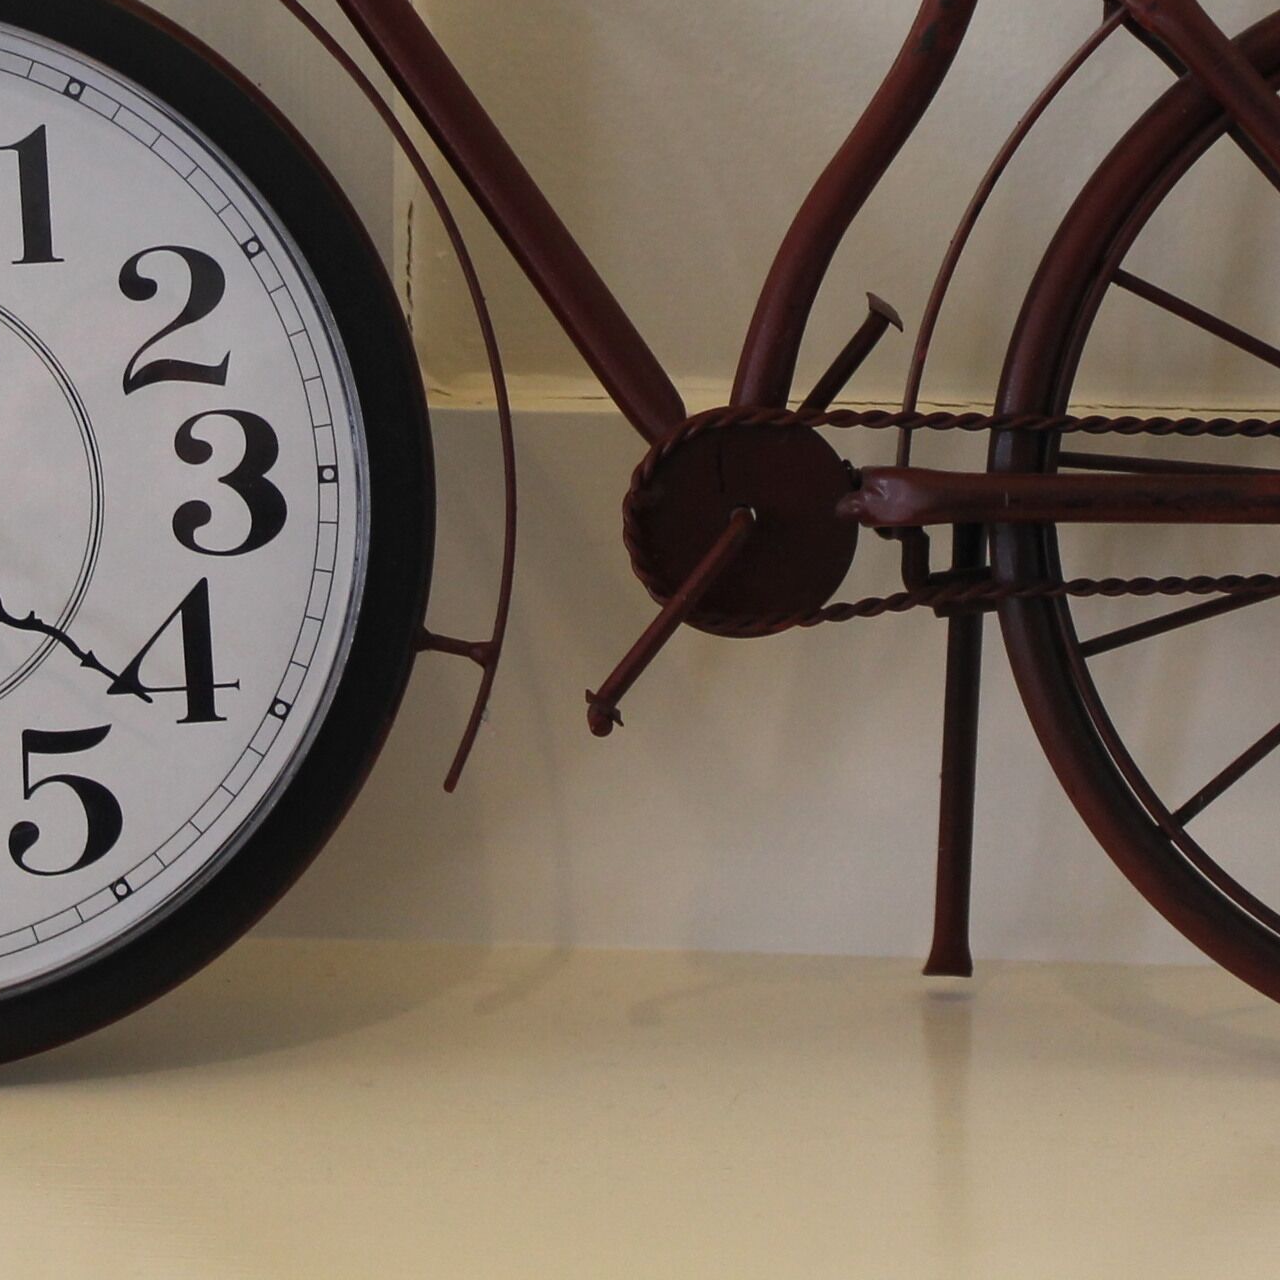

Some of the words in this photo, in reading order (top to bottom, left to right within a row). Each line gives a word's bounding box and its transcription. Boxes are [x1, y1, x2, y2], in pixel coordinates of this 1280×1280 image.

[119, 246, 229, 395] 2
[172, 410, 287, 556] 3
[110, 577, 240, 724] 4
[9, 724, 123, 876] 5
